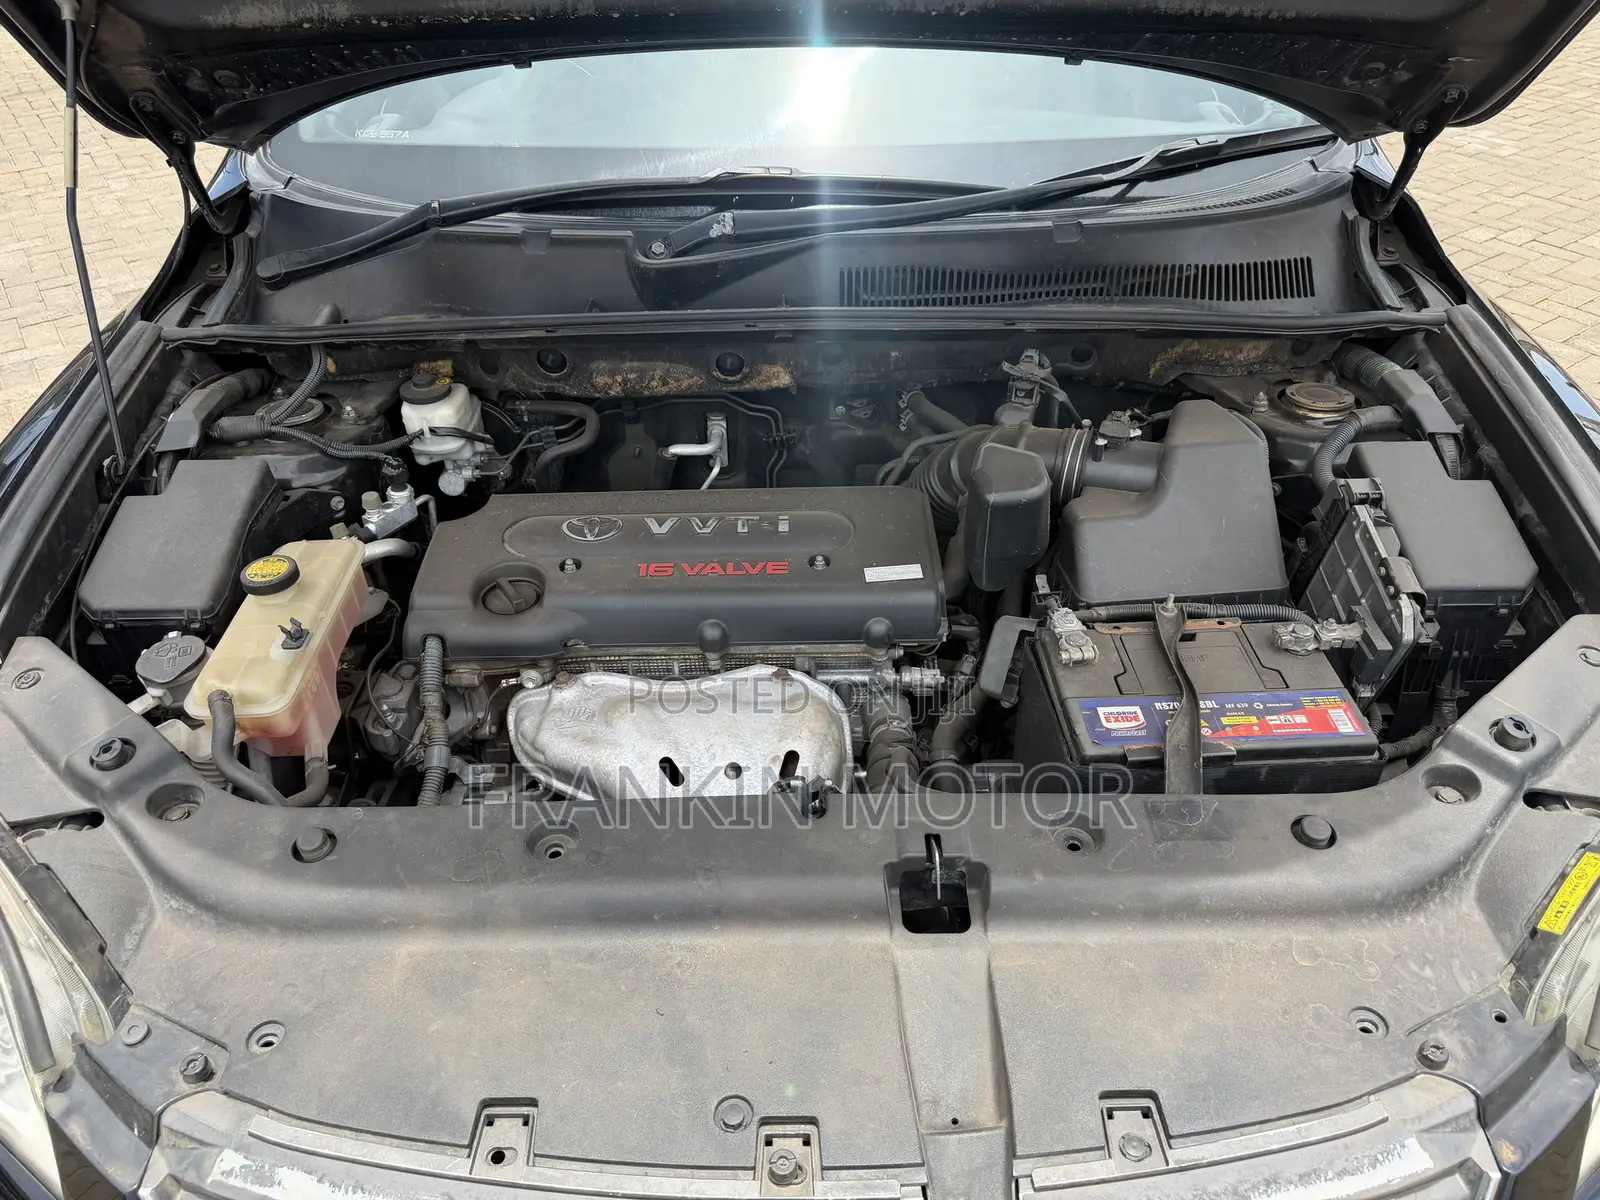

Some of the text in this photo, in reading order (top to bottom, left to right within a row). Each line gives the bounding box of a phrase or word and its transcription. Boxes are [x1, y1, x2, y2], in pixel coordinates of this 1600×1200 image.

[637, 561, 789, 577] 16 VALVE
[1103, 714, 1141, 724] EXIDE
